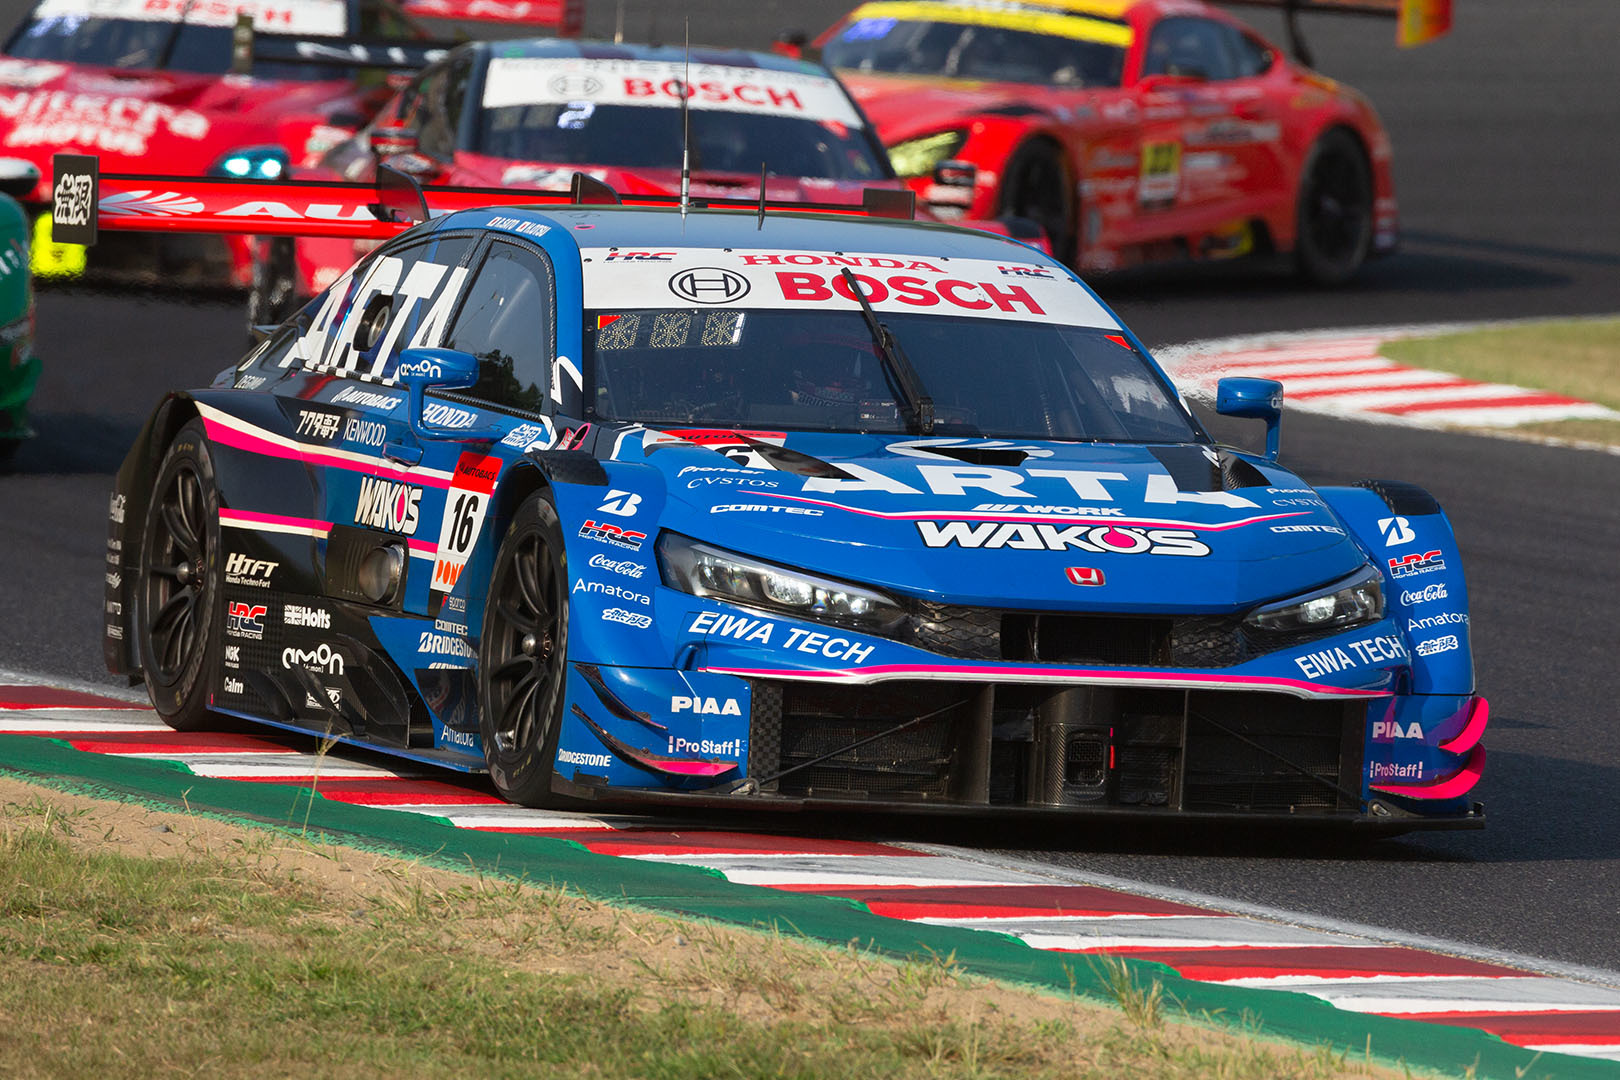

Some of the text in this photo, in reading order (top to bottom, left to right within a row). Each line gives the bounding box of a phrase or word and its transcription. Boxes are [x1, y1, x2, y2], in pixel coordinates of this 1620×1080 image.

[624, 77, 804, 109] BOSCH
[738, 254, 949, 275] HONDA
[774, 271, 1048, 316] BOSCH
[278, 255, 469, 386] ARTA
[342, 388, 402, 411] AUTOBACS
[422, 402, 479, 428] HONDA
[343, 417, 387, 447] KENWOOD
[461, 466, 496, 481] AUTOBACS
[687, 477, 779, 489] CVSTOS
[801, 463, 1262, 509] ARTA
[709, 503, 824, 516] COMTEC
[1021, 504, 1126, 517] WORK
[448, 493, 480, 554] 16
[578, 519, 648, 549] HRC
[1269, 524, 1347, 537] COMTEC
[589, 553, 648, 579] Coca-Cola
[1388, 549, 1445, 576] HRC
[572, 578, 651, 606] Amatora
[1400, 583, 1449, 607] Coca-Cola
[226, 600, 267, 634] HRC
[300, 606, 331, 629] Holts
[435, 619, 469, 636] COMTEC
[1408, 611, 1469, 632] Amatora
[688, 611, 875, 665] EIWA TECH
[225, 645, 240, 663] NGK
[1294, 635, 1408, 679] EIWA TECH
[224, 676, 244, 694] Calm
[671, 696, 742, 716] PIAA
[1372, 721, 1424, 739] PIAA
[558, 748, 612, 768] BRIDGESTONE
